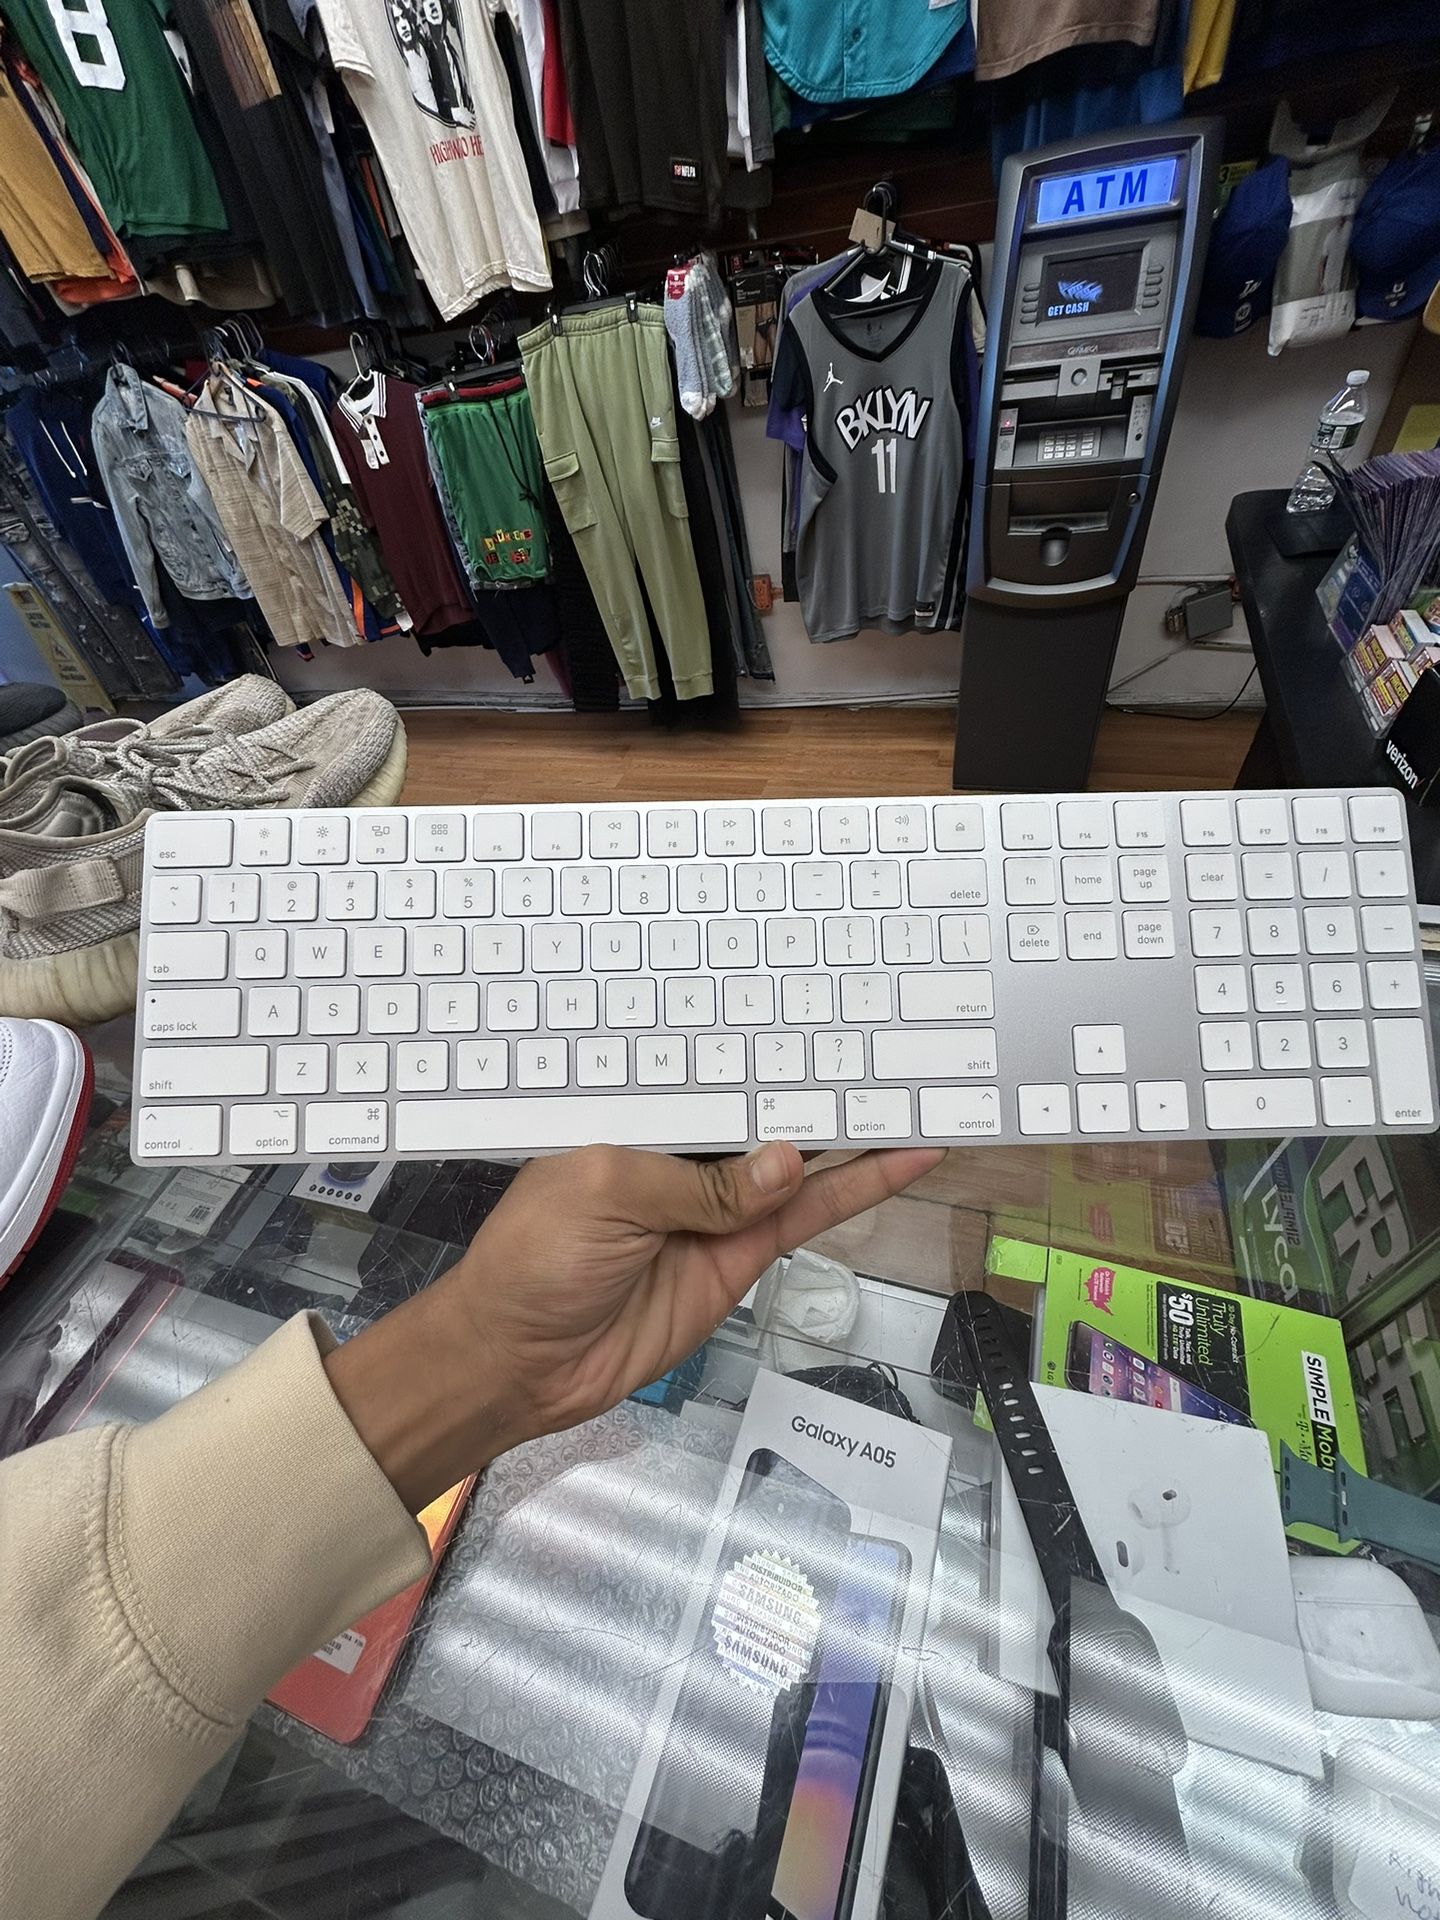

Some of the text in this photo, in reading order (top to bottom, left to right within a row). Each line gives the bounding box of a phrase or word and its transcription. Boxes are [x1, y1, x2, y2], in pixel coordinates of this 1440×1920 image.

[46, 0, 126, 91] 8
[1062, 168, 1148, 216] ATM
[1047, 301, 1090, 318] GET CASH
[835, 387, 932, 451] BKLYN
[871, 437, 897, 494] 11
[1385, 739, 1419, 790] verizon
[1022, 833, 1035, 841] F13
[1078, 832, 1092, 840] F14
[1372, 826, 1386, 834] F19
[725, 839, 735, 847] F9
[782, 839, 795, 847] F10
[839, 837, 851, 845] F11
[896, 836, 909, 844] F12
[158, 850, 177, 859] esc
[259, 849, 268, 857] F1
[317, 848, 327, 856] F2
[375, 847, 385, 855] F3
[434, 845, 444, 853] F4
[1074, 875, 1102, 885] home
[1132, 868, 1157, 878] page
[1200, 872, 1225, 882] clear
[1025, 876, 1037, 886] fn
[1139, 880, 1153, 890] up
[522, 894, 532, 908] 6
[581, 892, 591, 906] 7
[639, 891, 649, 905] 8
[697, 890, 708, 904] 9
[756, 888, 766, 903] 0
[950, 889, 981, 900] delete
[229, 900, 236, 914] 1
[287, 898, 296, 913] 2
[345, 897, 355, 912] 3
[404, 896, 415, 910] 4
[463, 895, 474, 909] 5
[1137, 923, 1162, 934] page
[1212, 926, 1222, 940] 7
[1269, 924, 1280, 938] 8
[1326, 923, 1337, 937] 9
[786, 935, 796, 949] P
[1019, 937, 1050, 948] delete
[1083, 931, 1102, 941] end
[1137, 935, 1164, 945] down
[433, 943, 444, 957] R
[492, 942, 503, 956] T
[551, 940, 562, 954] Y
[610, 939, 621, 954] U
[672, 938, 676, 952] I
[727, 936, 739, 951] O
[254, 947, 267, 962] Q
[311, 945, 328, 960] W
[374, 944, 383, 959] E
[152, 963, 170, 974] tab
[1217, 982, 1227, 996] 4
[1275, 980, 1285, 995] 5
[1331, 979, 1342, 994] 6
[506, 998, 518, 1013] G
[566, 997, 577, 1012] H
[626, 996, 635, 1010] J
[684, 994, 695, 1009] K
[744, 993, 754, 1007] L
[267, 1004, 279, 1018] A
[328, 1002, 339, 1017] S
[387, 1001, 399, 1016] D
[448, 1000, 457, 1015] F
[956, 1004, 988, 1013] return
[150, 1021, 198, 1034] caps lock
[1224, 1039, 1231, 1053] 1
[1280, 1038, 1290, 1052] 2
[1338, 1036, 1349, 1051] 3
[356, 1060, 368, 1075] X
[416, 1058, 428, 1074] C
[476, 1057, 489, 1072] V
[537, 1056, 548, 1070] B
[596, 1055, 608, 1069] N
[655, 1053, 668, 1068] M
[967, 1059, 991, 1071] shift
[296, 1062, 307, 1076] Z
[148, 1080, 173, 1091] shift
[1255, 1096, 1266, 1111] 0
[1394, 1108, 1422, 1119] enter
[763, 1123, 814, 1134] command
[852, 1121, 886, 1133] option
[958, 1118, 995, 1129] control
[144, 1139, 181, 1150] control
[255, 1136, 289, 1149] option
[328, 1134, 380, 1146] command
[1168, 1292, 1194, 1326] $50
[1211, 1302, 1227, 1337] Truly
[1195, 1297, 1213, 1366] Unlimited
[1306, 1355, 1330, 1422] SIMPLE
[791, 1415, 897, 1468] Galaxy A05
[750, 1562, 804, 1593] DISTRIBUIDOR
[750, 1573, 799, 1602] AUTORIZADO
[740, 1584, 802, 1625] SAMSUNG
[734, 1624, 786, 1655] AUTORIZADO
[724, 1635, 788, 1678] SAMSUNG
